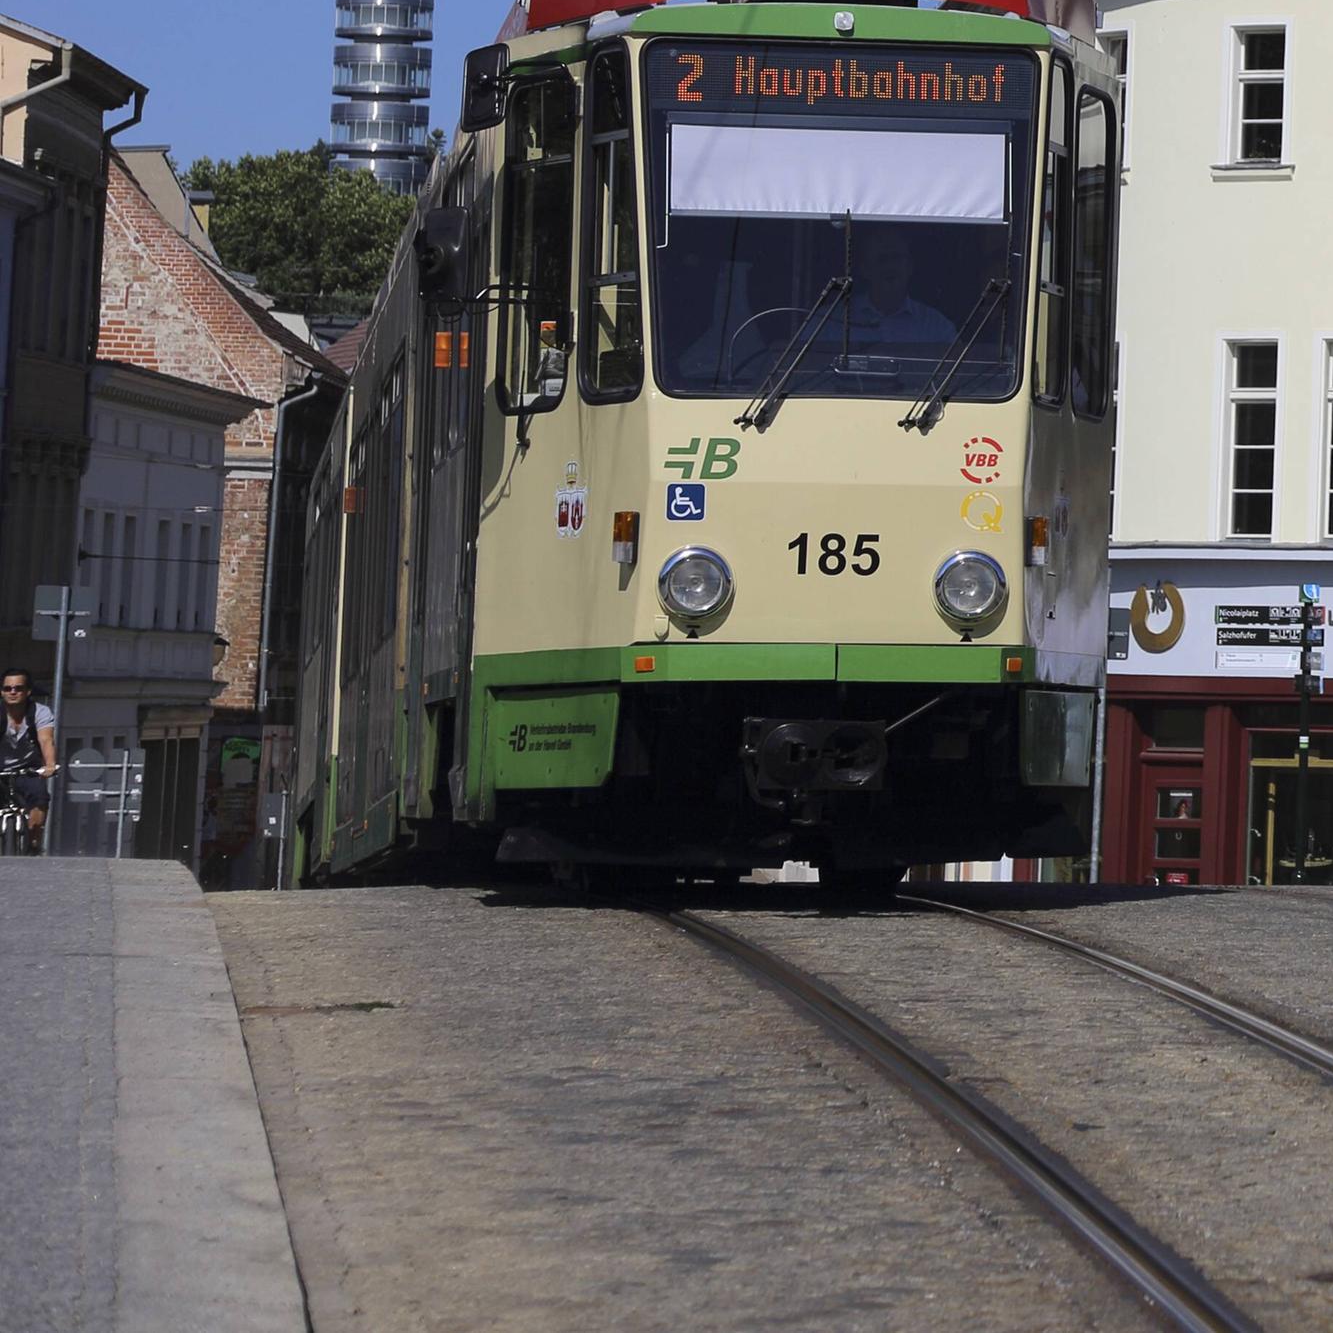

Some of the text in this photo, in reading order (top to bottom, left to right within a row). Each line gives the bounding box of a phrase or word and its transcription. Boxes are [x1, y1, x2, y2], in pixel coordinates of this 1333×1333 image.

[676, 54, 1005, 105] 2 Hauptbahnhof
[964, 453, 999, 468] VBB
[787, 532, 881, 577] 185
[1219, 609, 1260, 618] Nicolaiplatz
[1218, 630, 1257, 640] Salzhofufer
